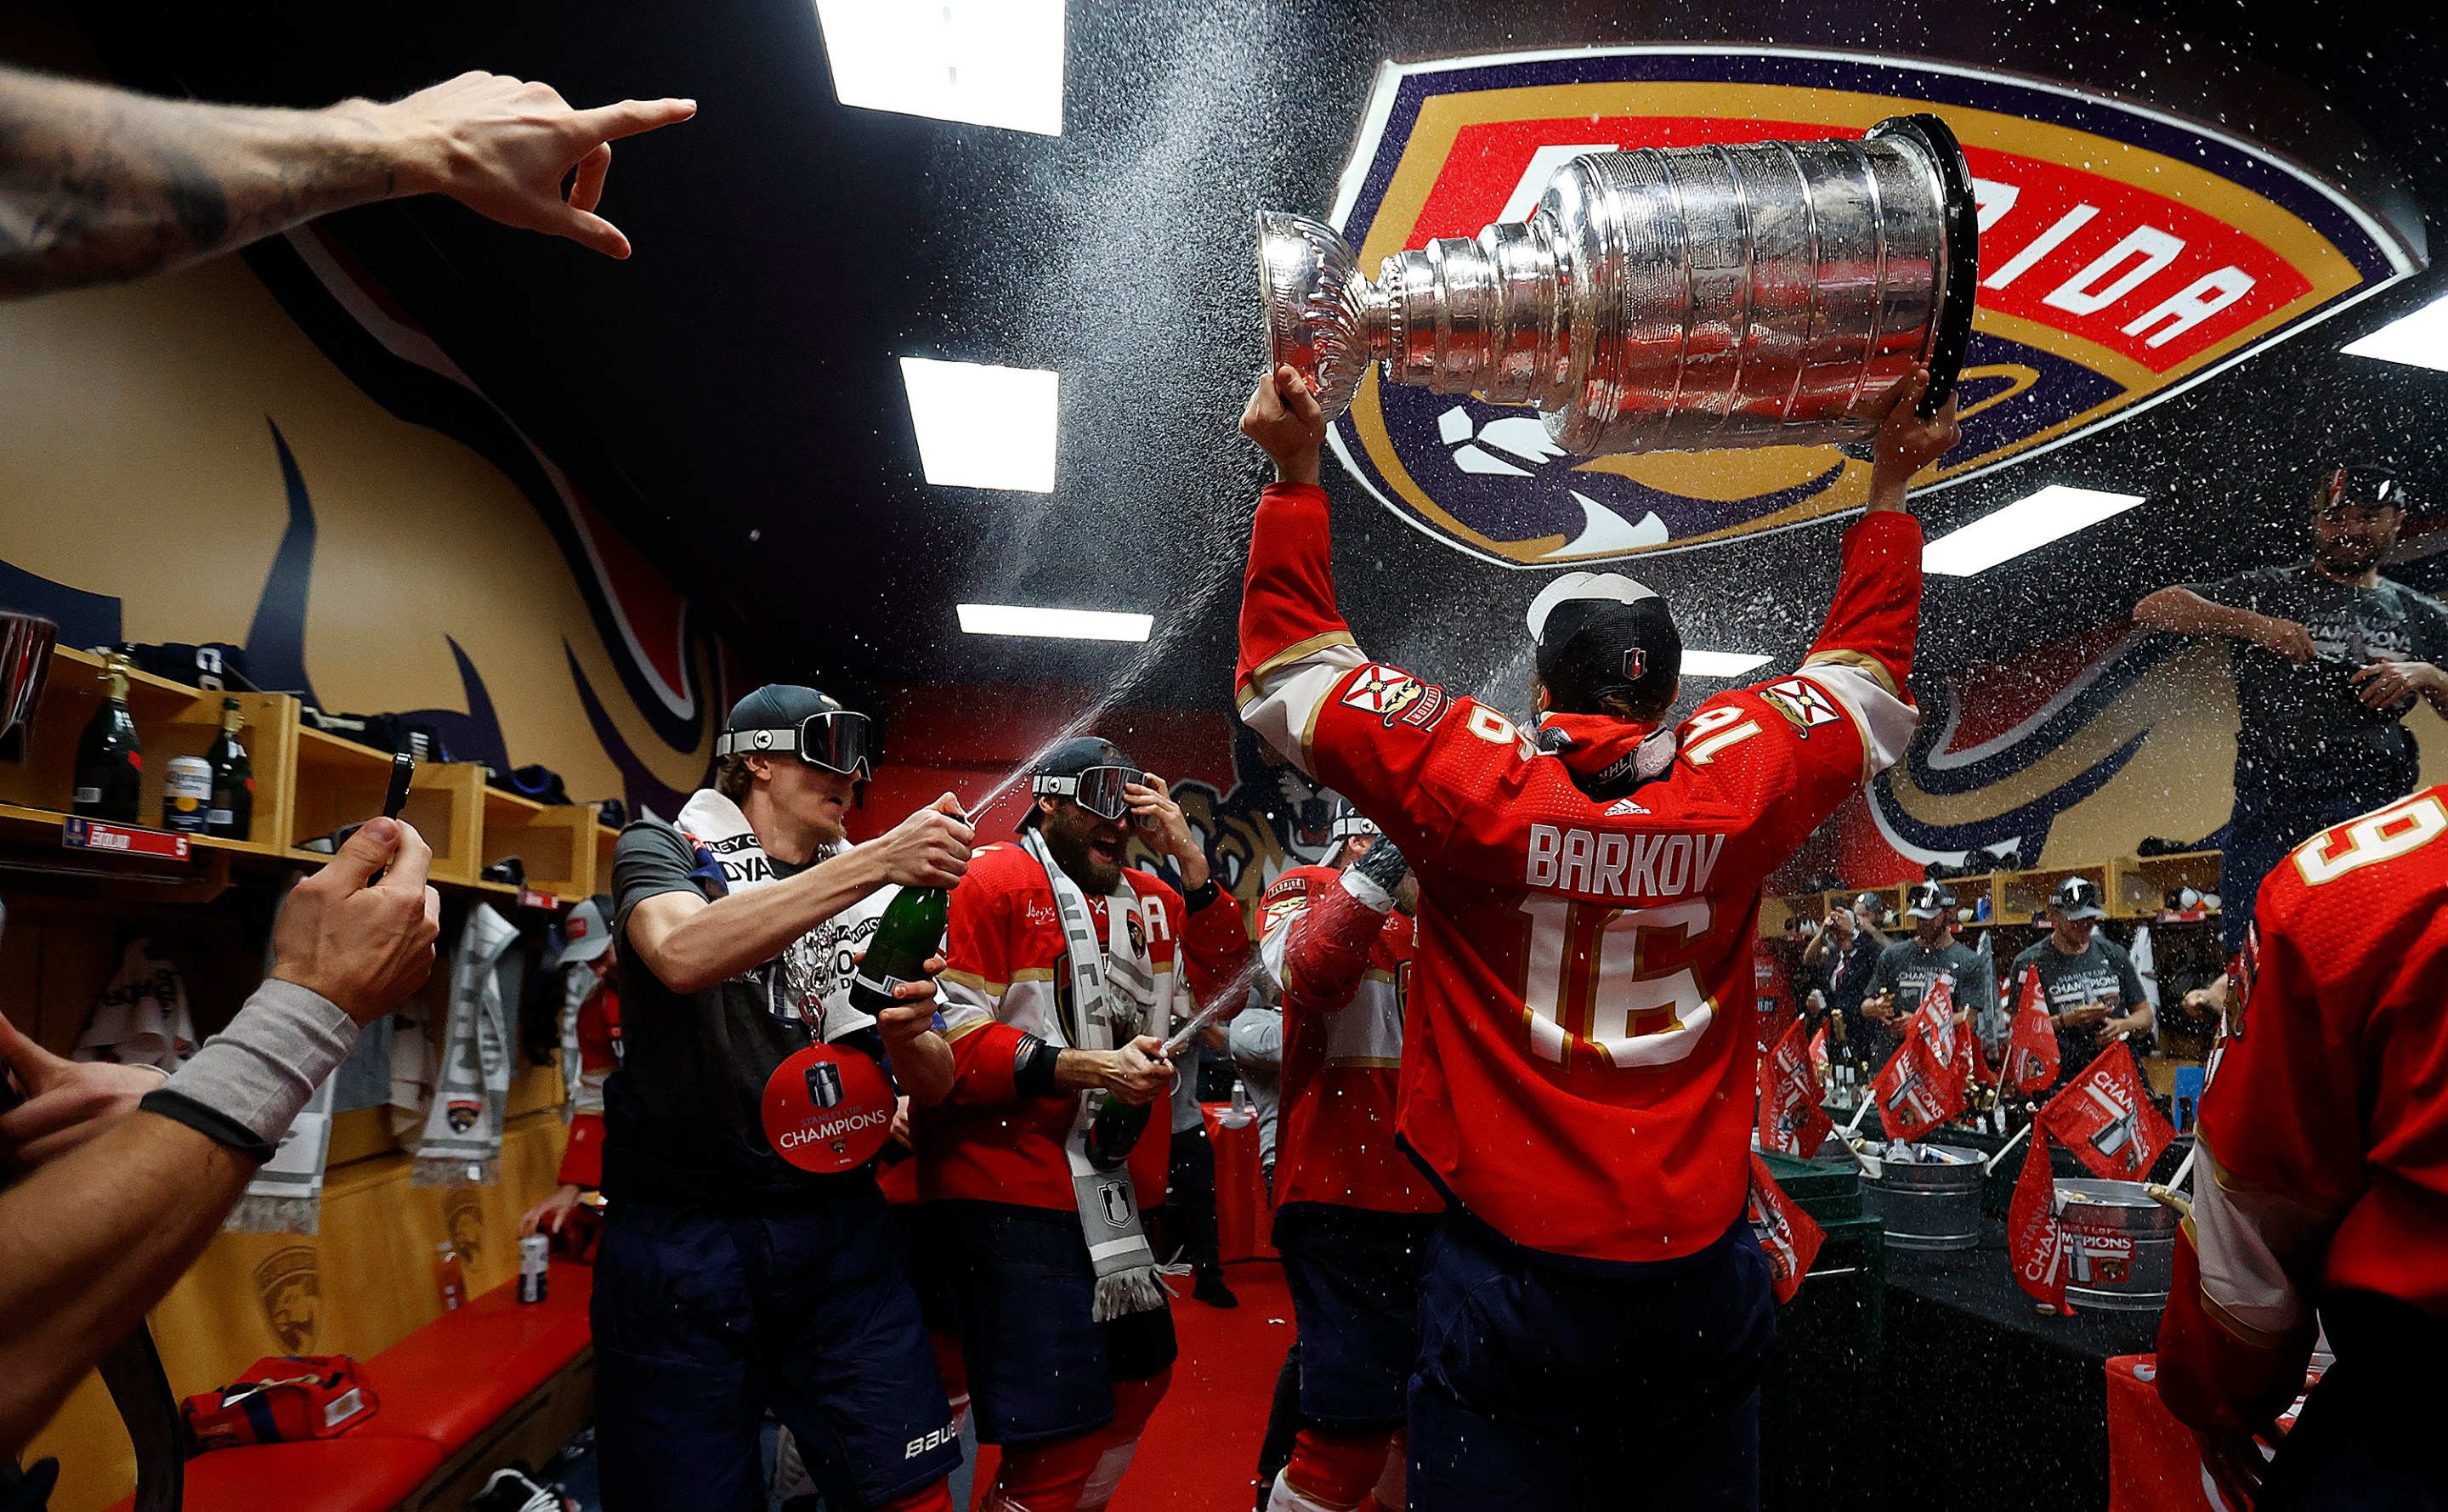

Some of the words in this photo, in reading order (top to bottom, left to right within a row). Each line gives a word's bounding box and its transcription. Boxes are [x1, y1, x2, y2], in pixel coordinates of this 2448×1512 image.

[1411, 689, 1438, 721] FLORIDA
[1604, 807, 1652, 817] adidas
[1526, 823, 1726, 897] BARKOV
[2291, 790, 2448, 886] 9
[1141, 895, 1171, 944] A
[1506, 892, 1718, 1071] 16
[779, 1109, 887, 1148] CHAMPIONS
